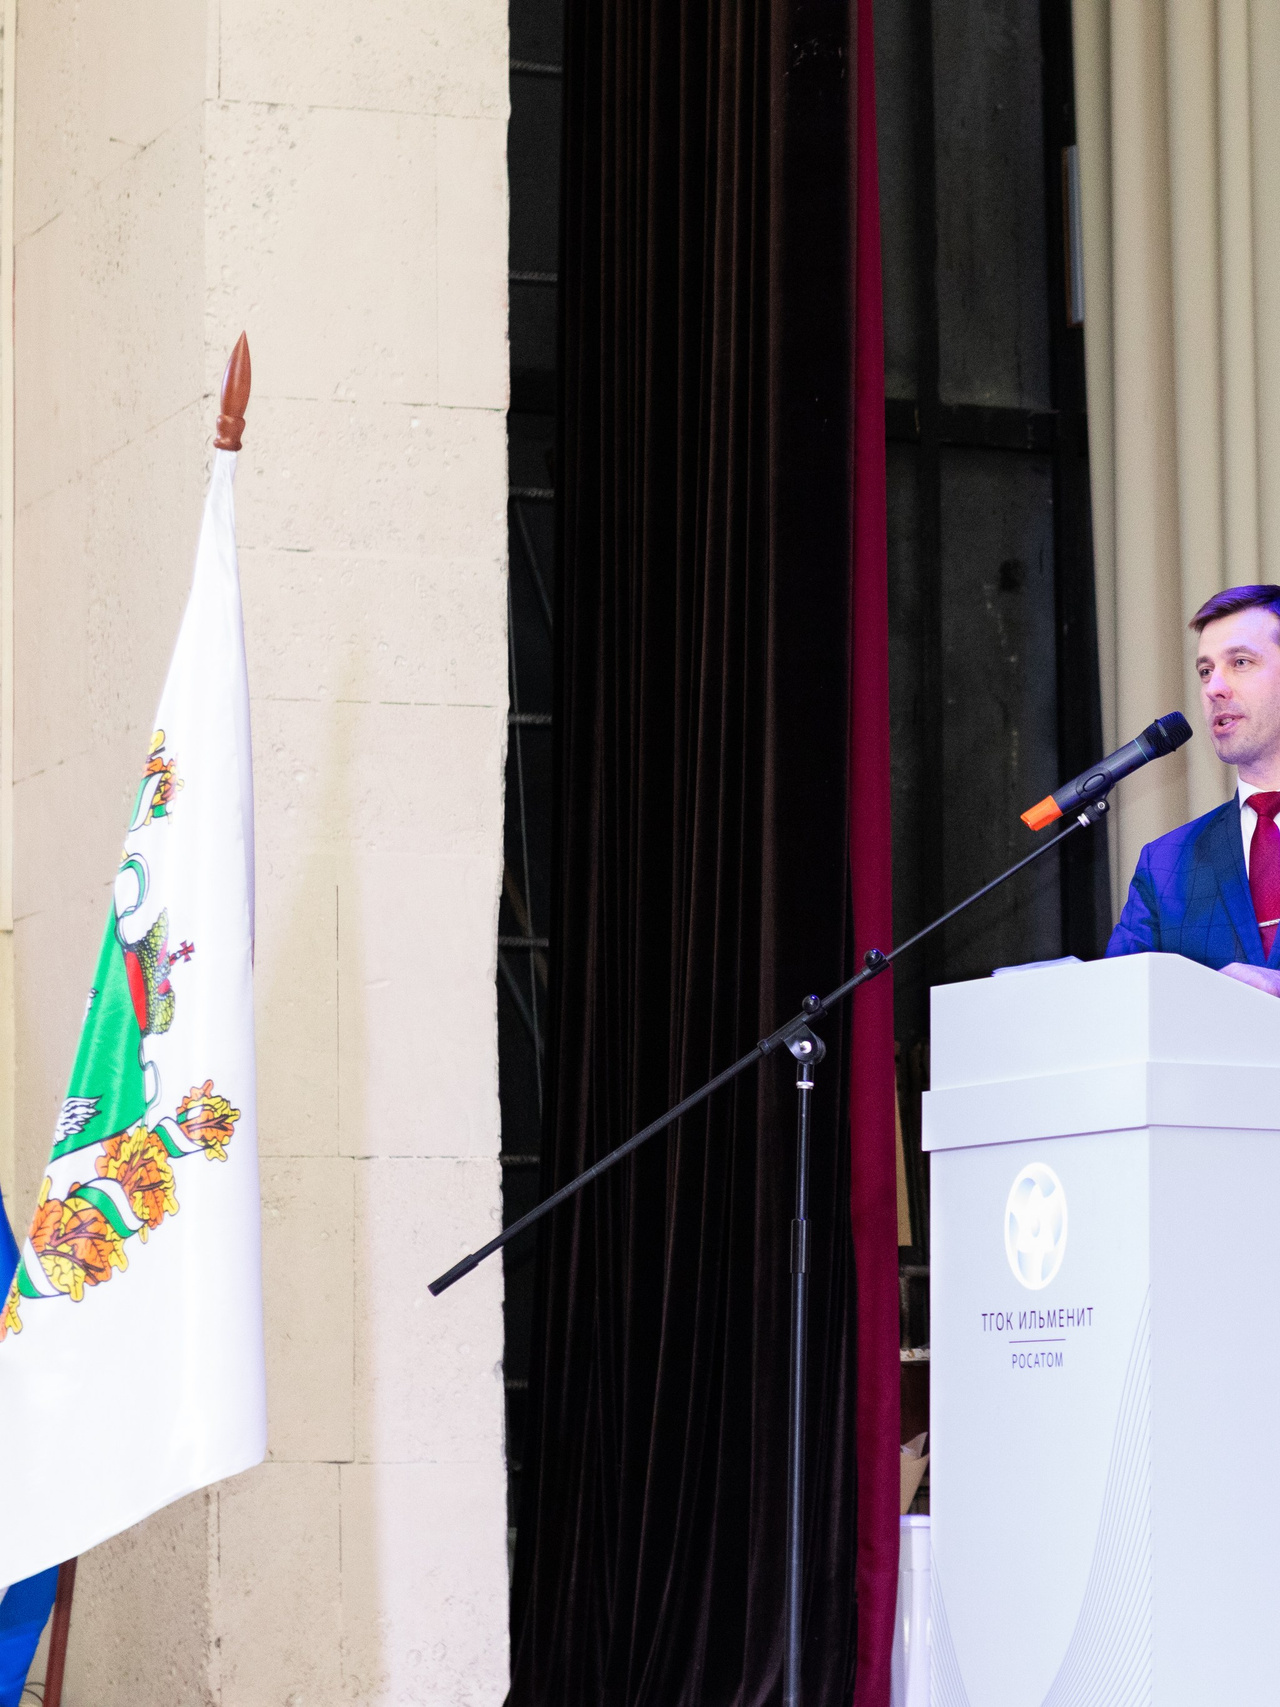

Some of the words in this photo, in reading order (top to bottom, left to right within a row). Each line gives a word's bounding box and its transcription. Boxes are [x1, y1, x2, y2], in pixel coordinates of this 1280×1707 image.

[981, 1312, 1014, 1332] ТГОК
[1019, 1307, 1094, 1330] ИЛЬМЕНИТ
[1011, 1352, 1064, 1369] РОСАТОМ
